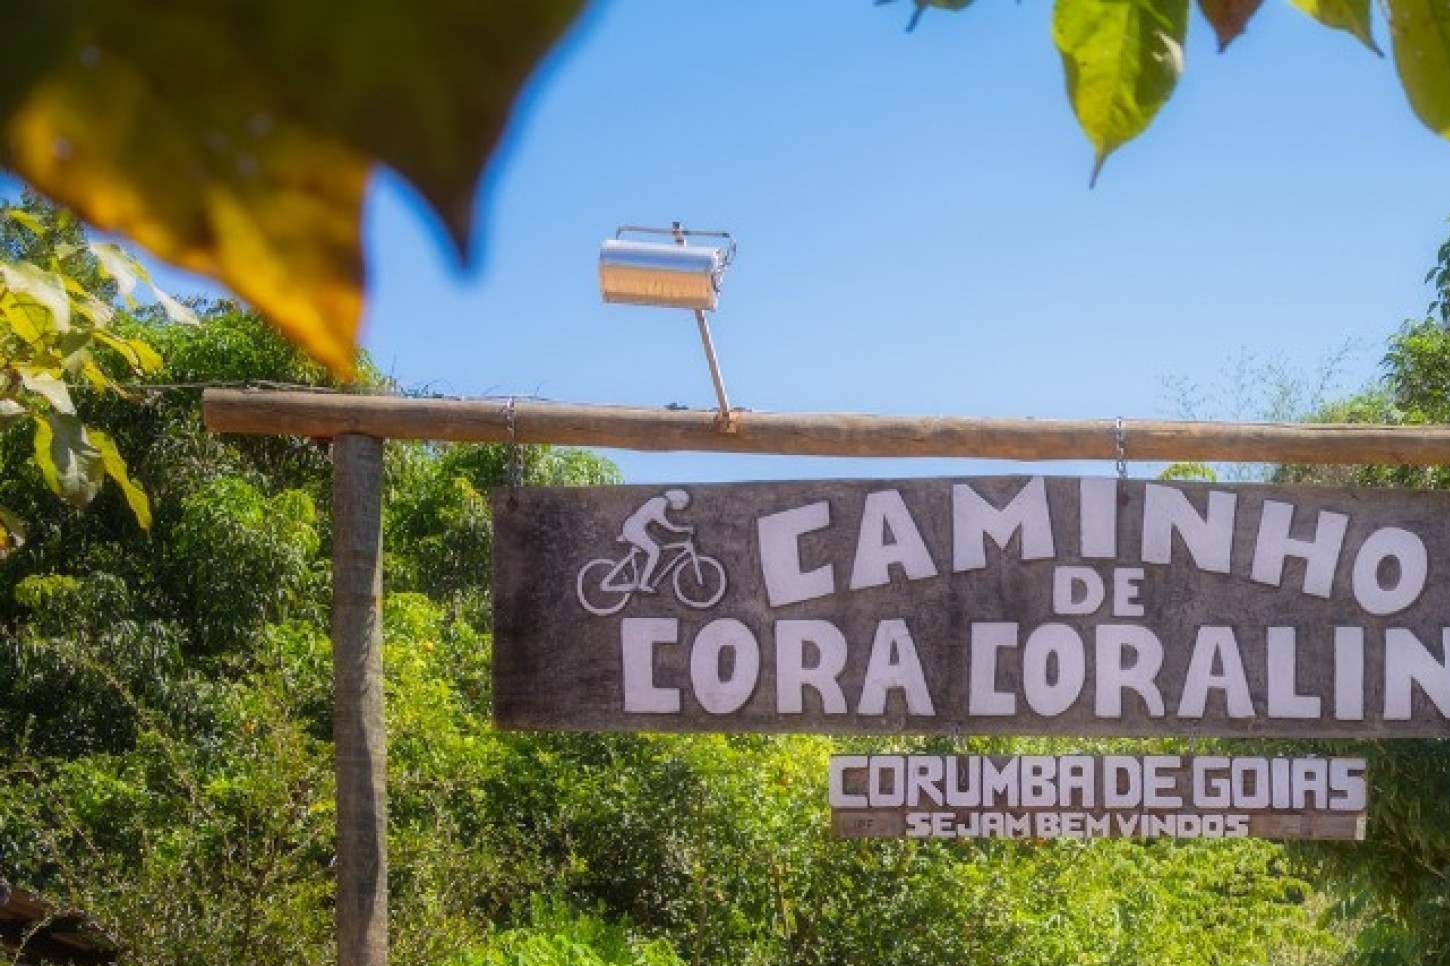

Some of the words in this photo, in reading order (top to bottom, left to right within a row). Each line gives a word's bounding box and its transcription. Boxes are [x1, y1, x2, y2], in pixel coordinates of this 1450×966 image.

[757, 476, 1428, 615] CAMINHO
[1053, 565, 1145, 617] DE
[621, 617, 936, 715] CORA
[829, 755, 1096, 807] CORUMBA
[1104, 756, 1184, 808] DE
[906, 811, 1030, 838] SEJAM
[1034, 812, 1111, 838] BEM
[1115, 813, 1249, 839] VINDOS
